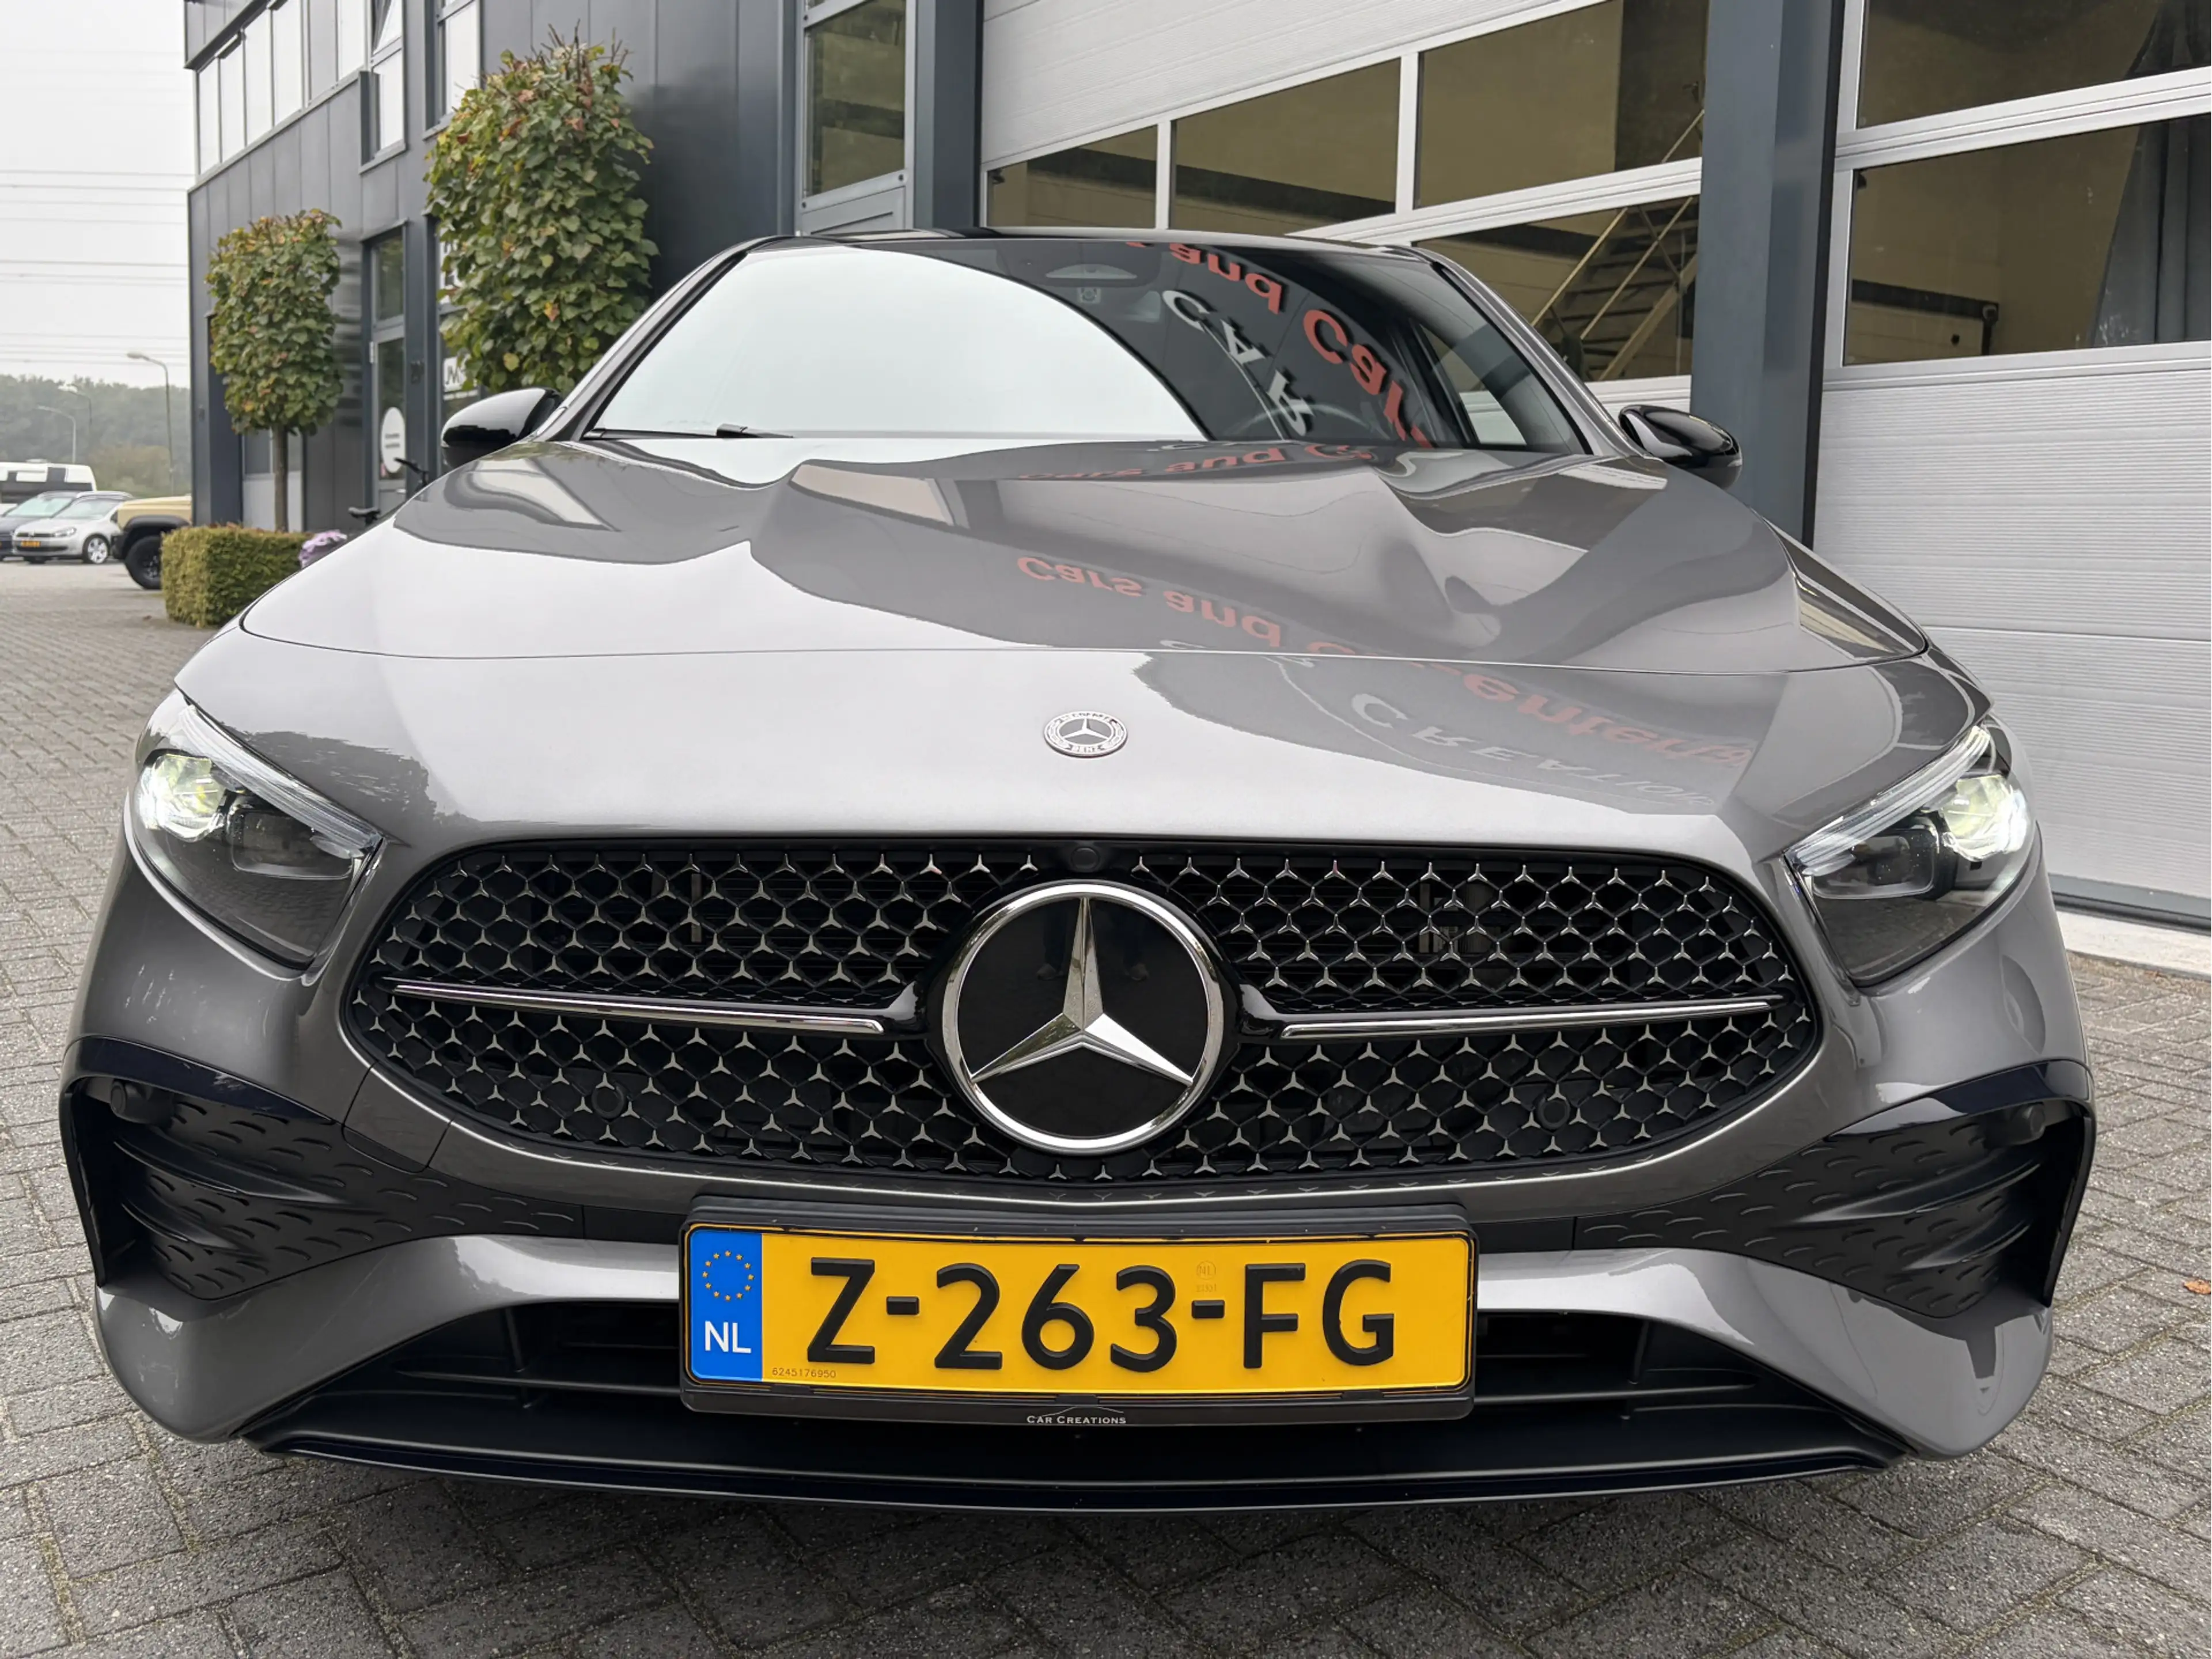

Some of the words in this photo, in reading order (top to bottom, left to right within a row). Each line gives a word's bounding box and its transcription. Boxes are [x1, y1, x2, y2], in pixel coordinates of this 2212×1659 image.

[807, 1257, 1394, 1373] Z-263-FG
[704, 1320, 752, 1354] NL
[1027, 1415, 1052, 1424] CAR
[1056, 1415, 1126, 1424] CREATIONS
